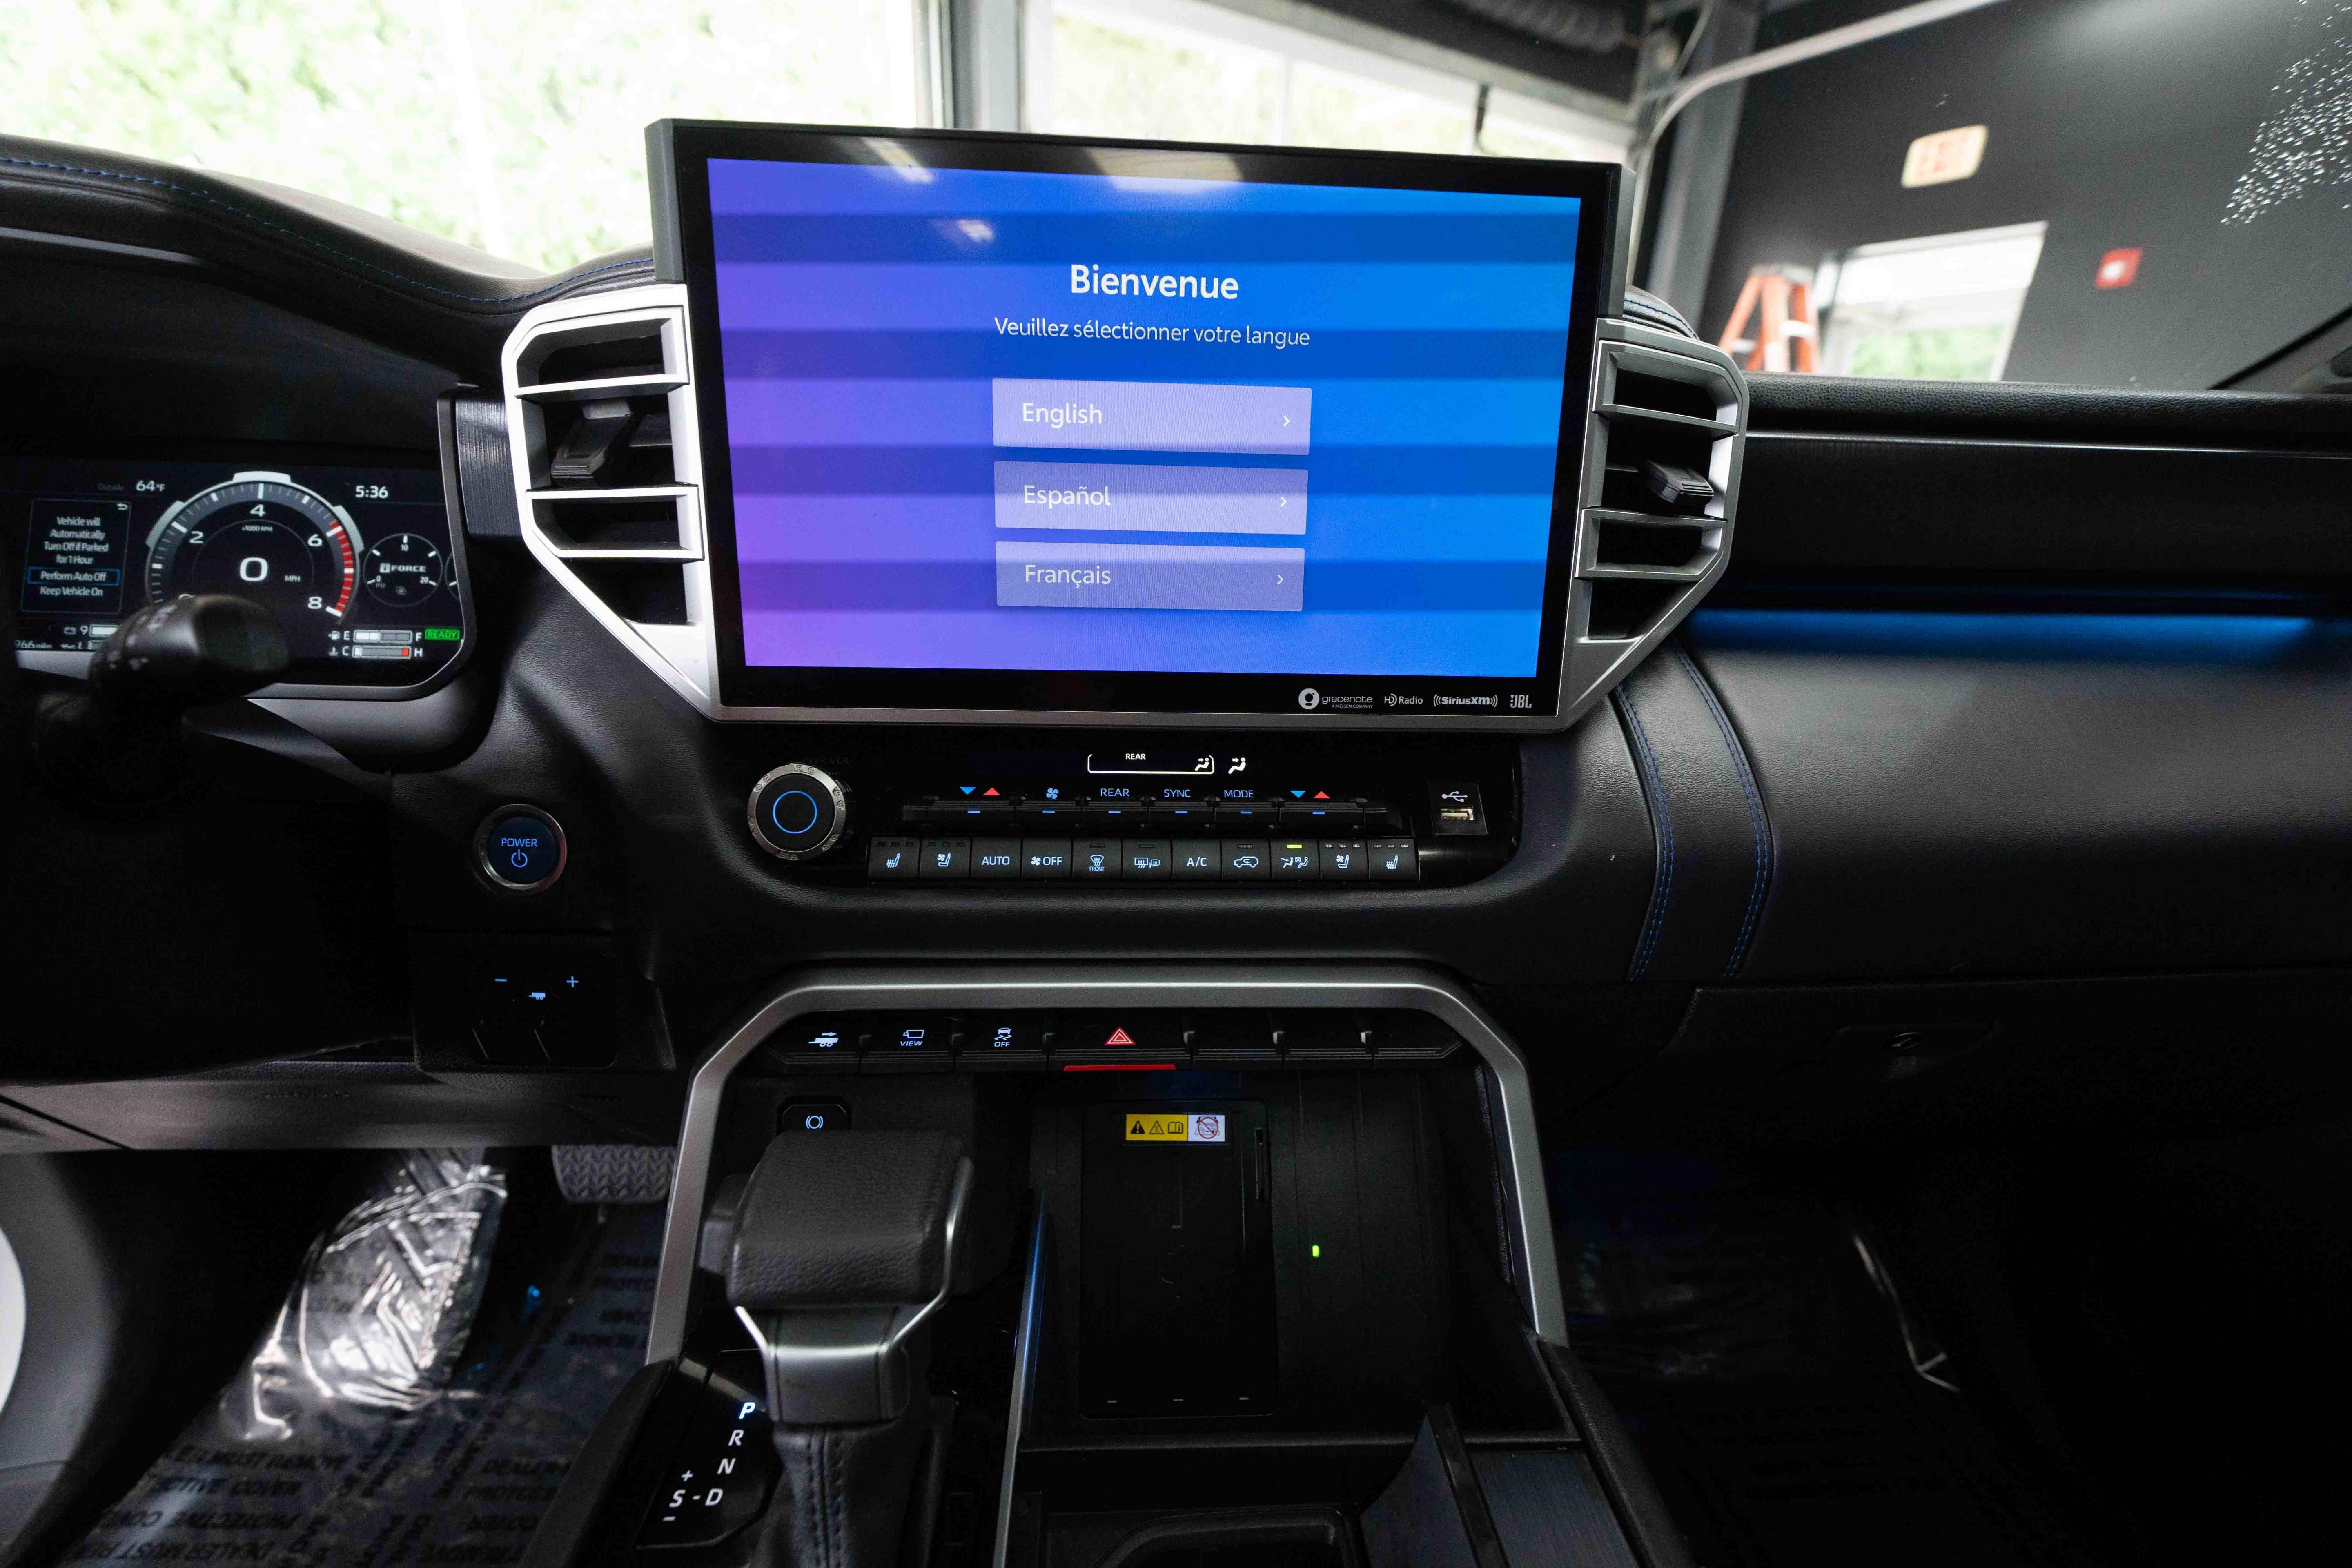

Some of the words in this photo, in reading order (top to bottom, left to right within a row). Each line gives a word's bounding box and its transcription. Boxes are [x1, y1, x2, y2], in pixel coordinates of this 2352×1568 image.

[1070, 264, 1240, 300] Bienvenue
[994, 317, 1069, 338] Veuillez
[1073, 320, 1189, 342] sélectionner
[1193, 327, 1242, 344] votre
[1245, 326, 1310, 350] langue
[1022, 402, 1102, 429] English
[355, 485, 389, 499] 5:36
[1023, 484, 1111, 509] Español
[250, 504, 265, 517] 4
[56, 516, 85, 527] Vehicle
[85, 517, 101, 527] will
[49, 529, 106, 541] Automatically
[189, 531, 204, 544] 2
[307, 534, 323, 547] 6
[44, 541, 62, 551] Turn
[62, 541, 76, 551] Off
[82, 543, 109, 552] Parked
[74, 555, 94, 565] Hour
[239, 557, 268, 582] 0
[40, 571, 72, 581] Perform
[74, 572, 94, 581] Auto
[94, 572, 107, 581] Off
[1024, 564, 1111, 588] Français
[40, 586, 61, 597] Keep
[62, 586, 90, 597] Vehicle
[91, 587, 104, 597] On
[307, 596, 322, 609] 8
[343, 630, 350, 641] E
[415, 632, 422, 641] F
[427, 630, 457, 639] READY
[342, 646, 349, 656] C
[414, 648, 423, 657] H
[1321, 695, 1373, 705] gracenote
[1399, 695, 1423, 704] Radio
[1510, 695, 1532, 708] JBL
[1100, 788, 1130, 797] REAR
[1164, 789, 1191, 797] SYNC
[1224, 790, 1254, 798] MODE
[501, 837, 538, 847] POWER
[981, 856, 1010, 865] AUTO
[1042, 856, 1062, 866] OFF
[1186, 856, 1207, 867] A/C
[739, 1401, 756, 1419] P
[728, 1430, 744, 1446] R
[717, 1458, 736, 1474] N
[669, 1489, 686, 1508] S
[705, 1488, 723, 1506] D
